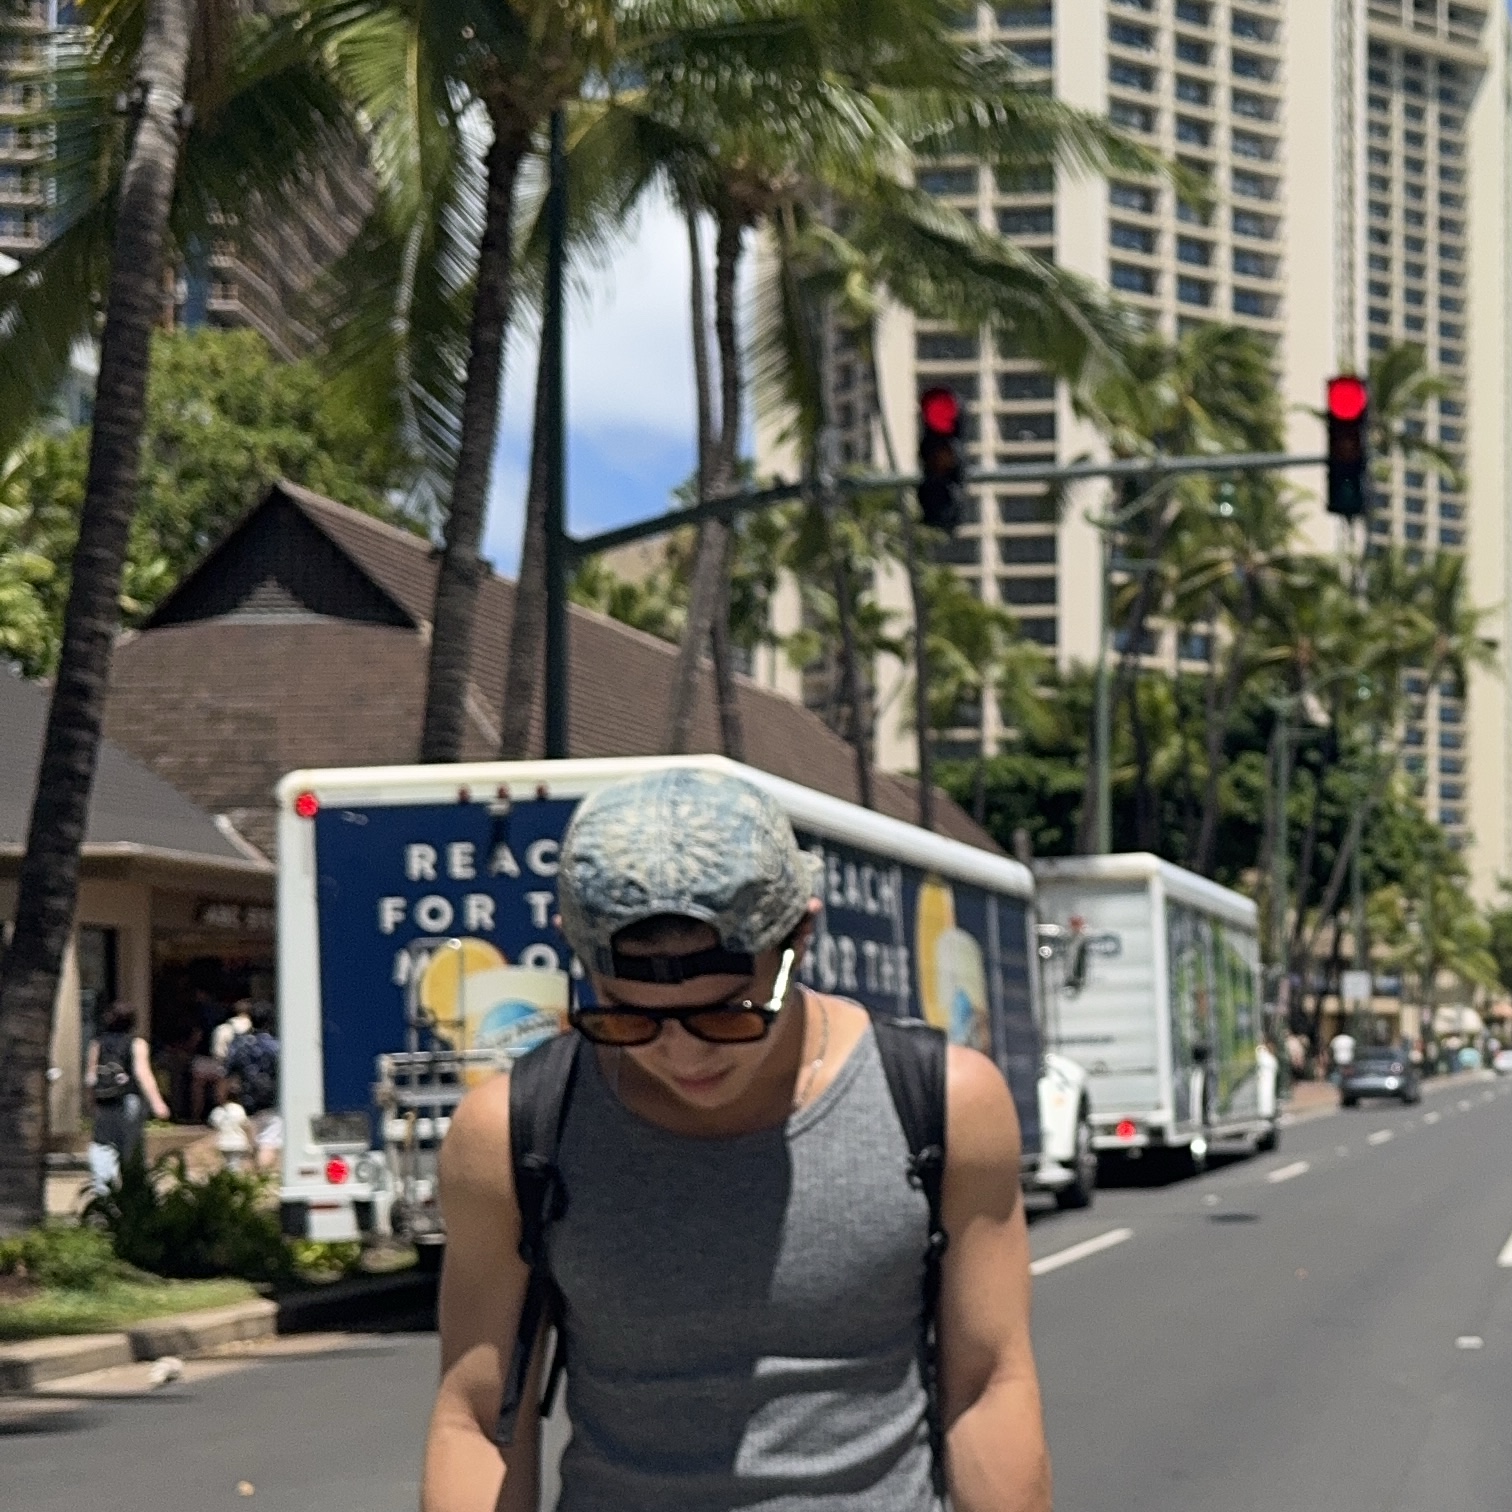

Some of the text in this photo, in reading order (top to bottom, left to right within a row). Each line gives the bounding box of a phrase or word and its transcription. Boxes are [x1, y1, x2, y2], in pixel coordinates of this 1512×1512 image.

[404, 838, 560, 882] REAC
[823, 849, 903, 917] EACH
[377, 894, 496, 934] FOR
[862, 938, 909, 997] THE
